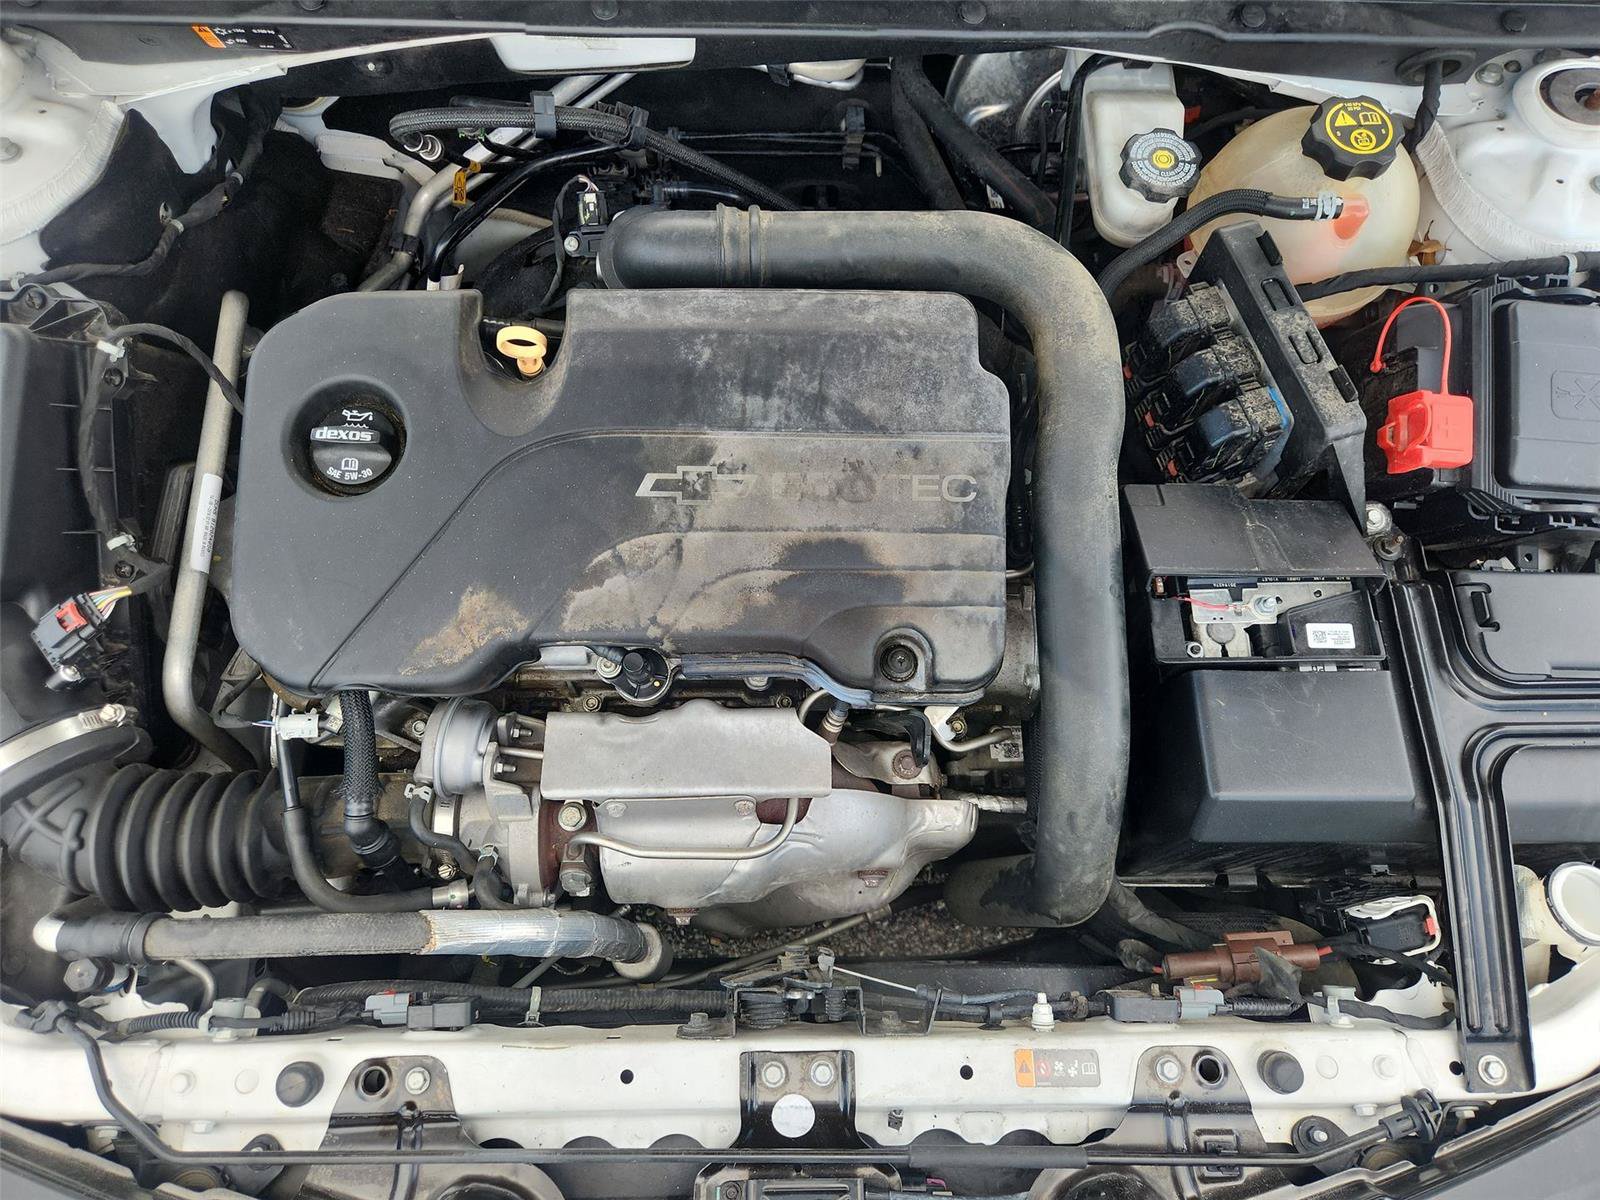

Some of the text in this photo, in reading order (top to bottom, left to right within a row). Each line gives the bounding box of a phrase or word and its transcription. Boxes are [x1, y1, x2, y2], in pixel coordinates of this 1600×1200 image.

[315, 426, 375, 442] dexos
[326, 466, 373, 480] SAE 5W-30
